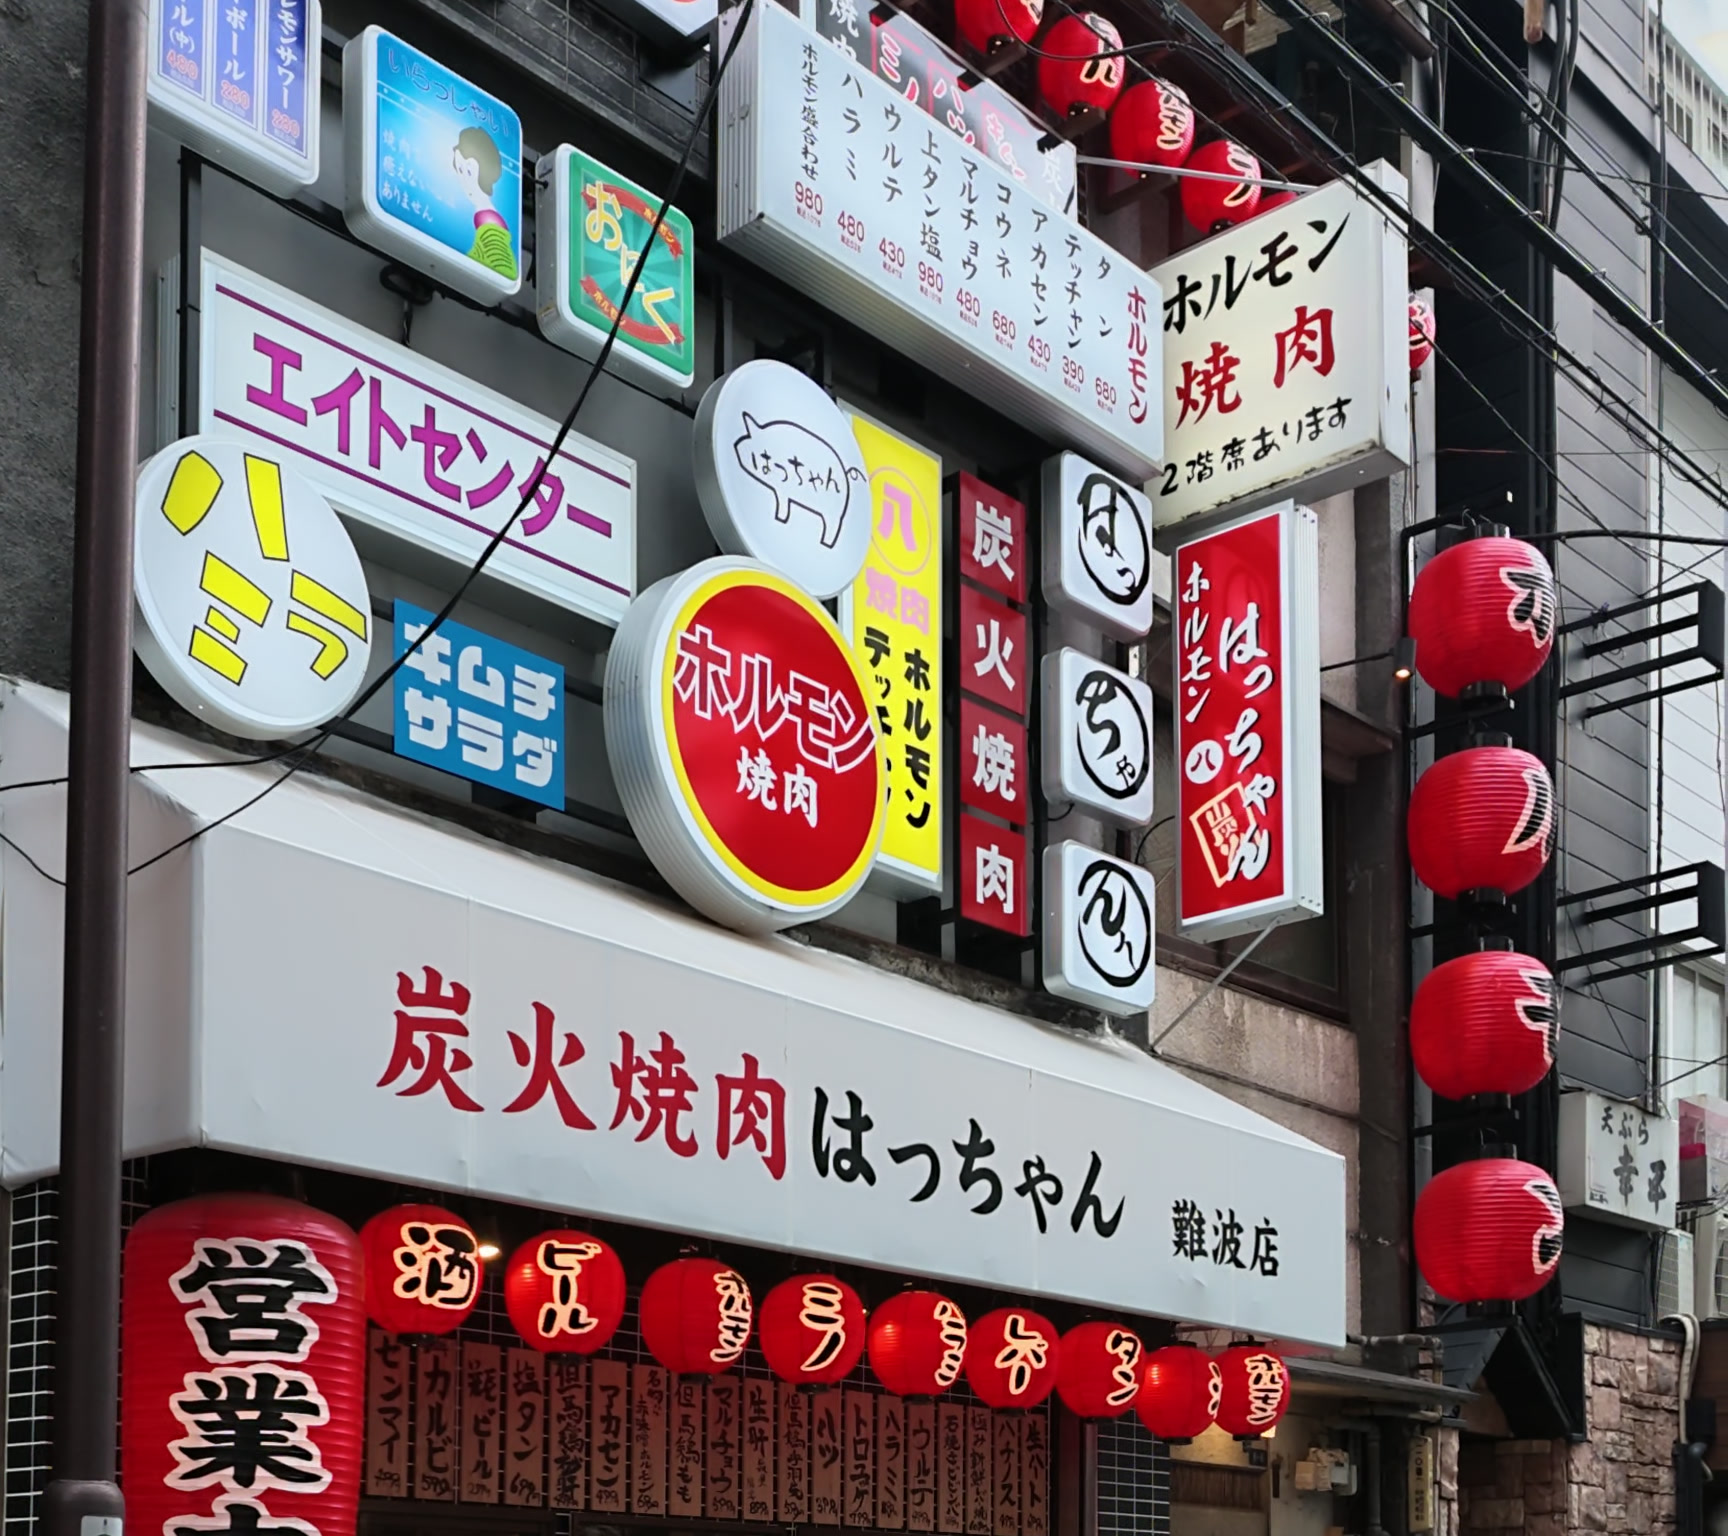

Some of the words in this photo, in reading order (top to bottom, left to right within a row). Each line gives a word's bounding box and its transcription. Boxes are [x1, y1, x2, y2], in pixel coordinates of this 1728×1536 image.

[169, 0, 195, 53] ル(中)
[223, 0, 248, 81] ボール
[388, 48, 509, 137] いらっしゃい
[801, 43, 818, 181] ホルモン盛合わせ
[841, 73, 863, 181] ハラミ
[794, 181, 823, 215] 980
[882, 104, 903, 202] ウルテ
[920, 129, 943, 262] 上タン塩
[585, 180, 676, 345] おにく
[837, 210, 865, 242] 480
[879, 237, 905, 268] 430
[960, 157, 979, 280] マルチョウ
[996, 183, 1012, 279] コウネ
[1030, 208, 1048, 327] アカセン
[918, 261, 943, 293] 980
[956, 288, 981, 318] 480
[1064, 233, 1082, 349] テッチャン
[1163, 212, 1350, 335] ホルモン
[992, 310, 1016, 341] 680
[1028, 334, 1050, 362] 430
[1062, 355, 1084, 384] 390
[1127, 285, 1148, 424] ホルモン
[1175, 305, 1335, 430] 焼肉
[246, 332, 612, 539] エイトセンター
[1095, 377, 1116, 405] 680
[1160, 396, 1352, 497] 2階席あります
[161, 450, 368, 686] ハラミ
[877, 483, 915, 553] 八
[865, 567, 931, 635] 焼肉
[1181, 561, 1212, 723] ホルモン
[404, 622, 557, 722] キムチ
[673, 624, 878, 775] ホルモン
[972, 500, 1017, 915] 炭火焼肉
[404, 687, 557, 788] サラダ
[736, 746, 819, 829] 焼肉
[904, 648, 931, 829] ホルモン
[1218, 602, 1276, 881] はっちゃん
[376, 965, 786, 1181] 炭火焼肉
[812, 1086, 1125, 1238] はっちゃん
[1171, 1199, 1280, 1277] 難波店
[394, 1222, 479, 1309] 酒
[537, 1240, 601, 1338] ビール
[799, 1282, 845, 1371] ミノ
[375, 1336, 401, 1464] センマイ
[423, 1343, 452, 1474] カルビ
[513, 1360, 542, 1461] 塩タン
[596, 1385, 621, 1488] アカセン
[710, 1387, 735, 1493] マルチョウ
[817, 1408, 839, 1469] ハツ
[884, 1410, 901, 1501] ハラミ
[910, 1419, 933, 1506] ウルテ
[999, 1420, 1016, 1506] ハチノス
